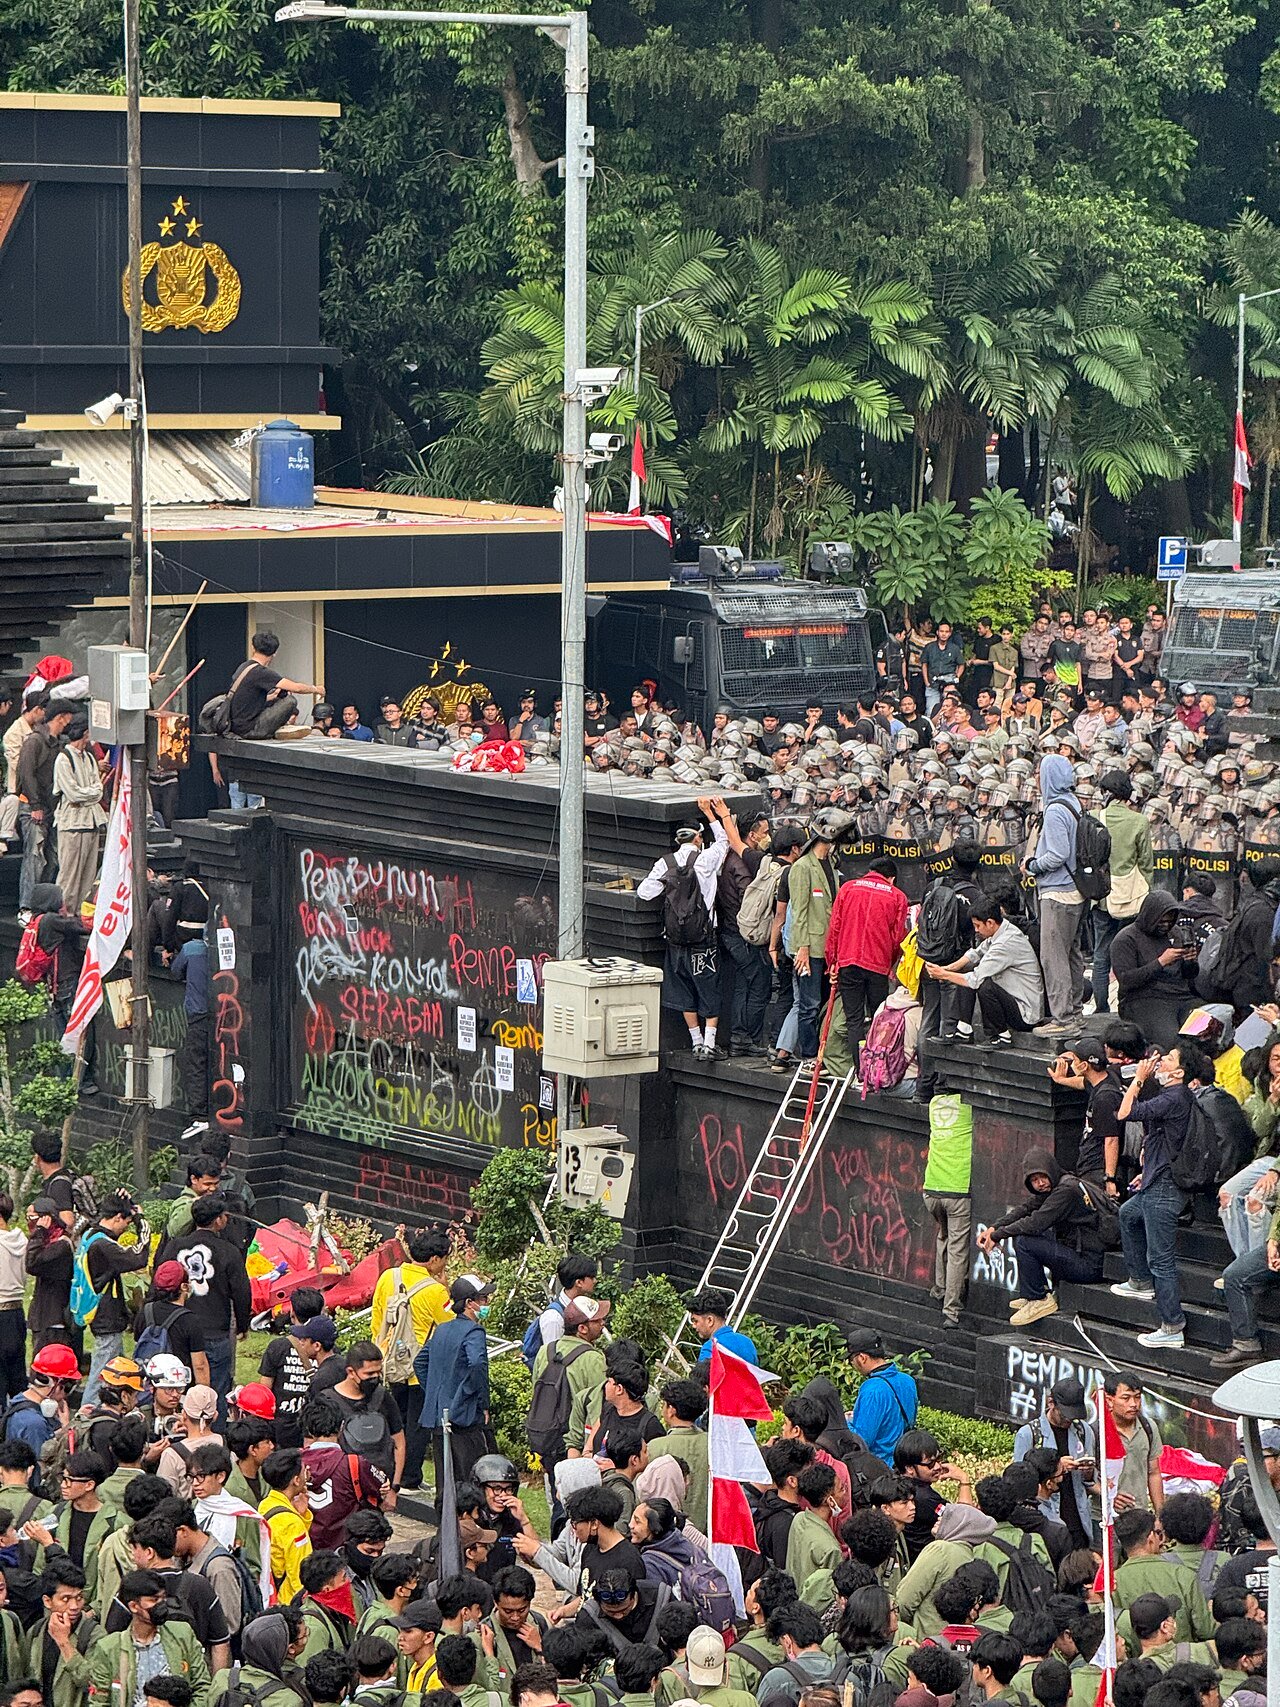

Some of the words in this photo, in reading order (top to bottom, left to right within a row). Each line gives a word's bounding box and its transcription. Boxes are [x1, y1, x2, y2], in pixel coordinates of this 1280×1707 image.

[1165, 540, 1181, 564] P
[842, 841, 875, 856] OLISI
[884, 842, 922, 858] POLISI
[930, 860, 953, 873] POLI
[979, 854, 1016, 866] POLISI
[1190, 857, 1230, 872] POLISI
[565, 1145, 581, 1172] 13
[973, 1251, 1019, 1292] ANJ
[283, 1365, 306, 1374] WHE
